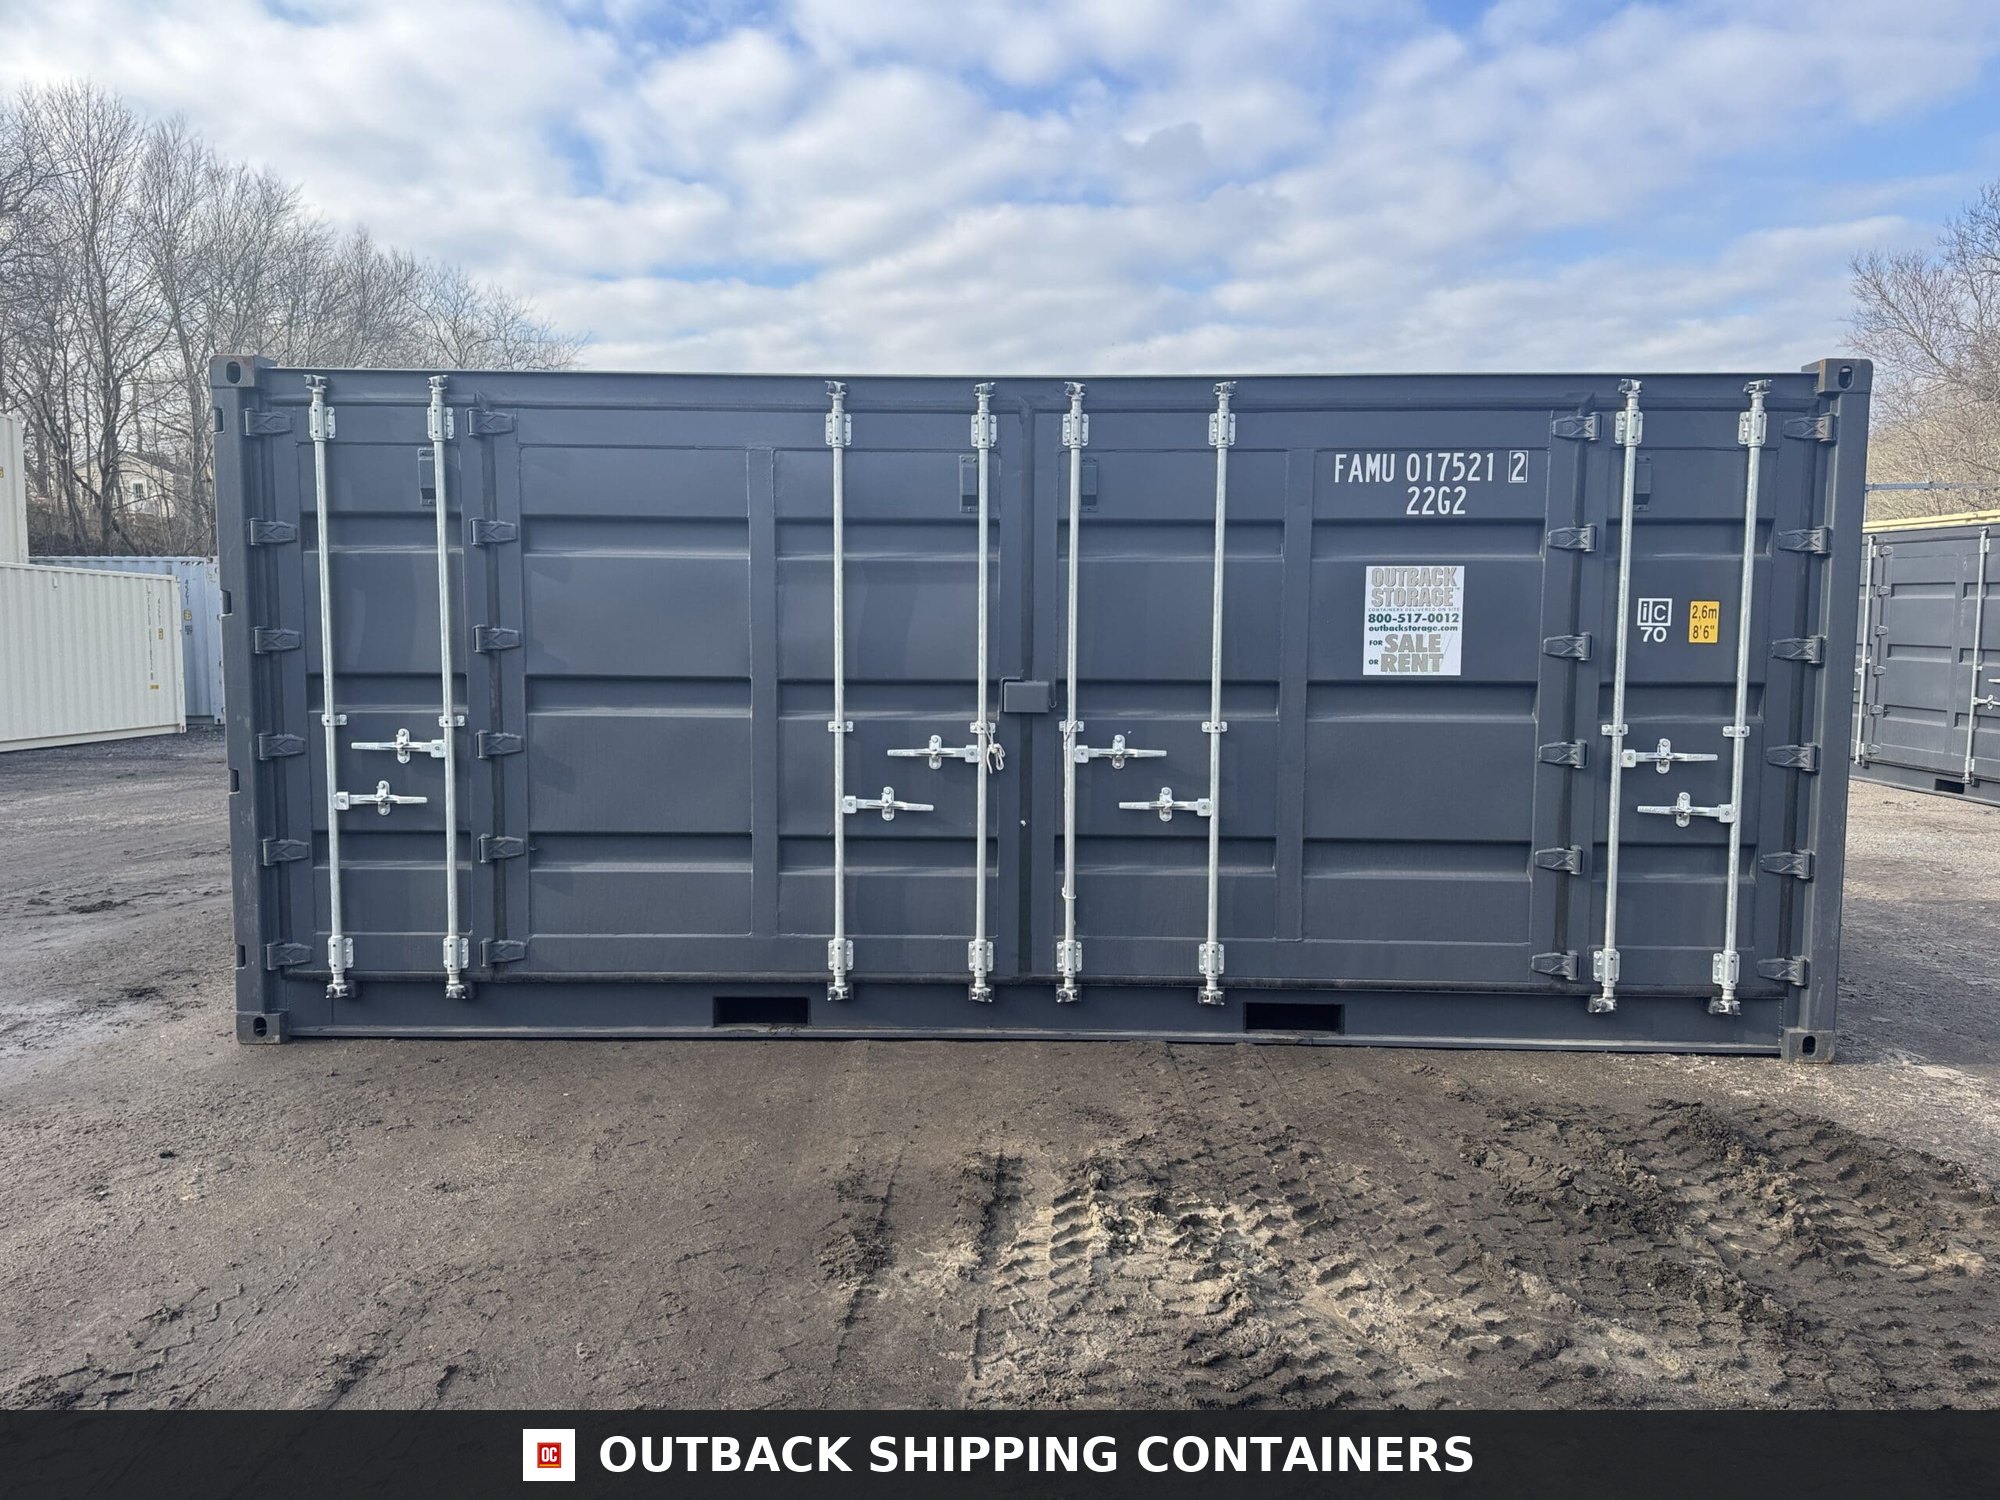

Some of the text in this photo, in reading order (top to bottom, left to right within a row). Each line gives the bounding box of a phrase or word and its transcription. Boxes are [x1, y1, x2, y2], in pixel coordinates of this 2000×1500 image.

[1334, 452, 1526, 483] FAMU 017521 2
[1406, 486, 1467, 515] 22G2
[1371, 567, 1457, 587] OUTBACK
[1371, 587, 1454, 607] STORAGE
[1367, 613, 1460, 624] 800-517-0012
[1691, 605, 1717, 621] 2,6m
[1368, 624, 1458, 633] outbackstorage.com
[1640, 626, 1667, 642] 70
[1384, 634, 1441, 653] SALE
[1380, 654, 1444, 673] RENT
